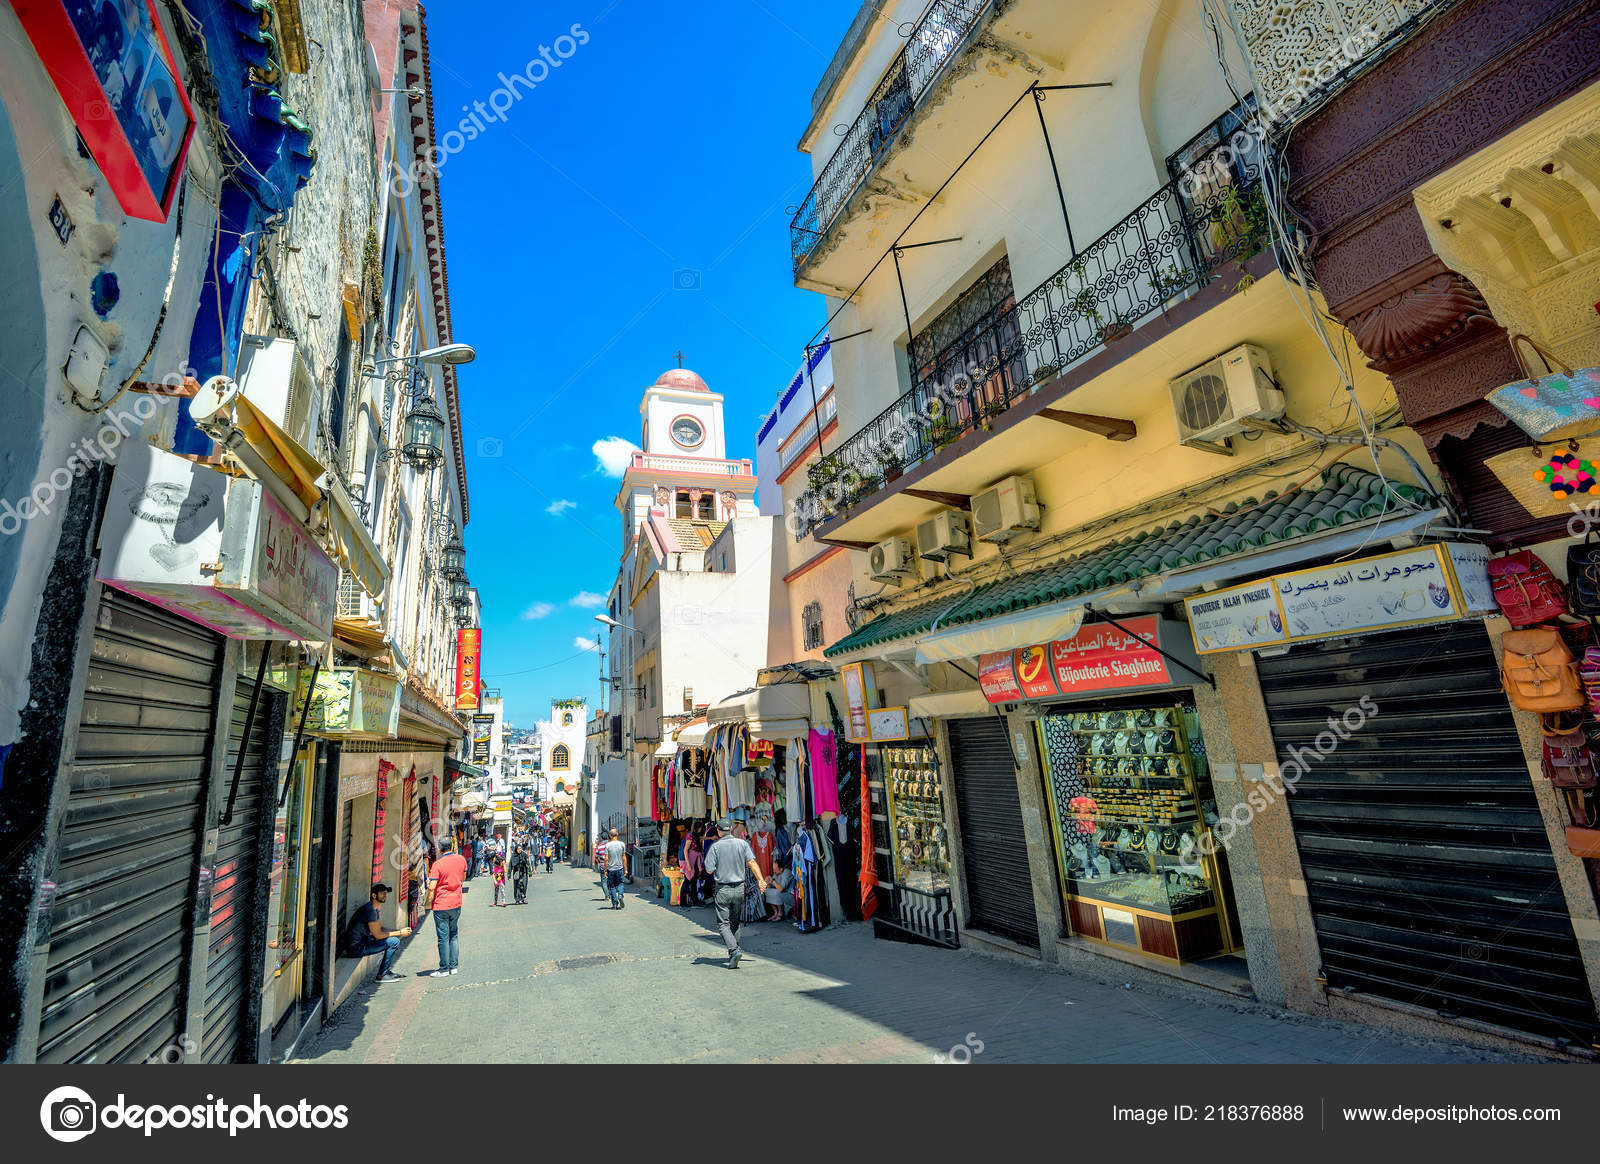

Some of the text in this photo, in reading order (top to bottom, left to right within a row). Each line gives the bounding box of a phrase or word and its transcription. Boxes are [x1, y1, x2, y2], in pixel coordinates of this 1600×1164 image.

[1358, 561, 1435, 581] مجوهرات
[1281, 580, 1328, 596] ينصرك
[1222, 595, 1242, 609] ALLAH
[1058, 658, 1162, 685] Bijouterie Siaghine
